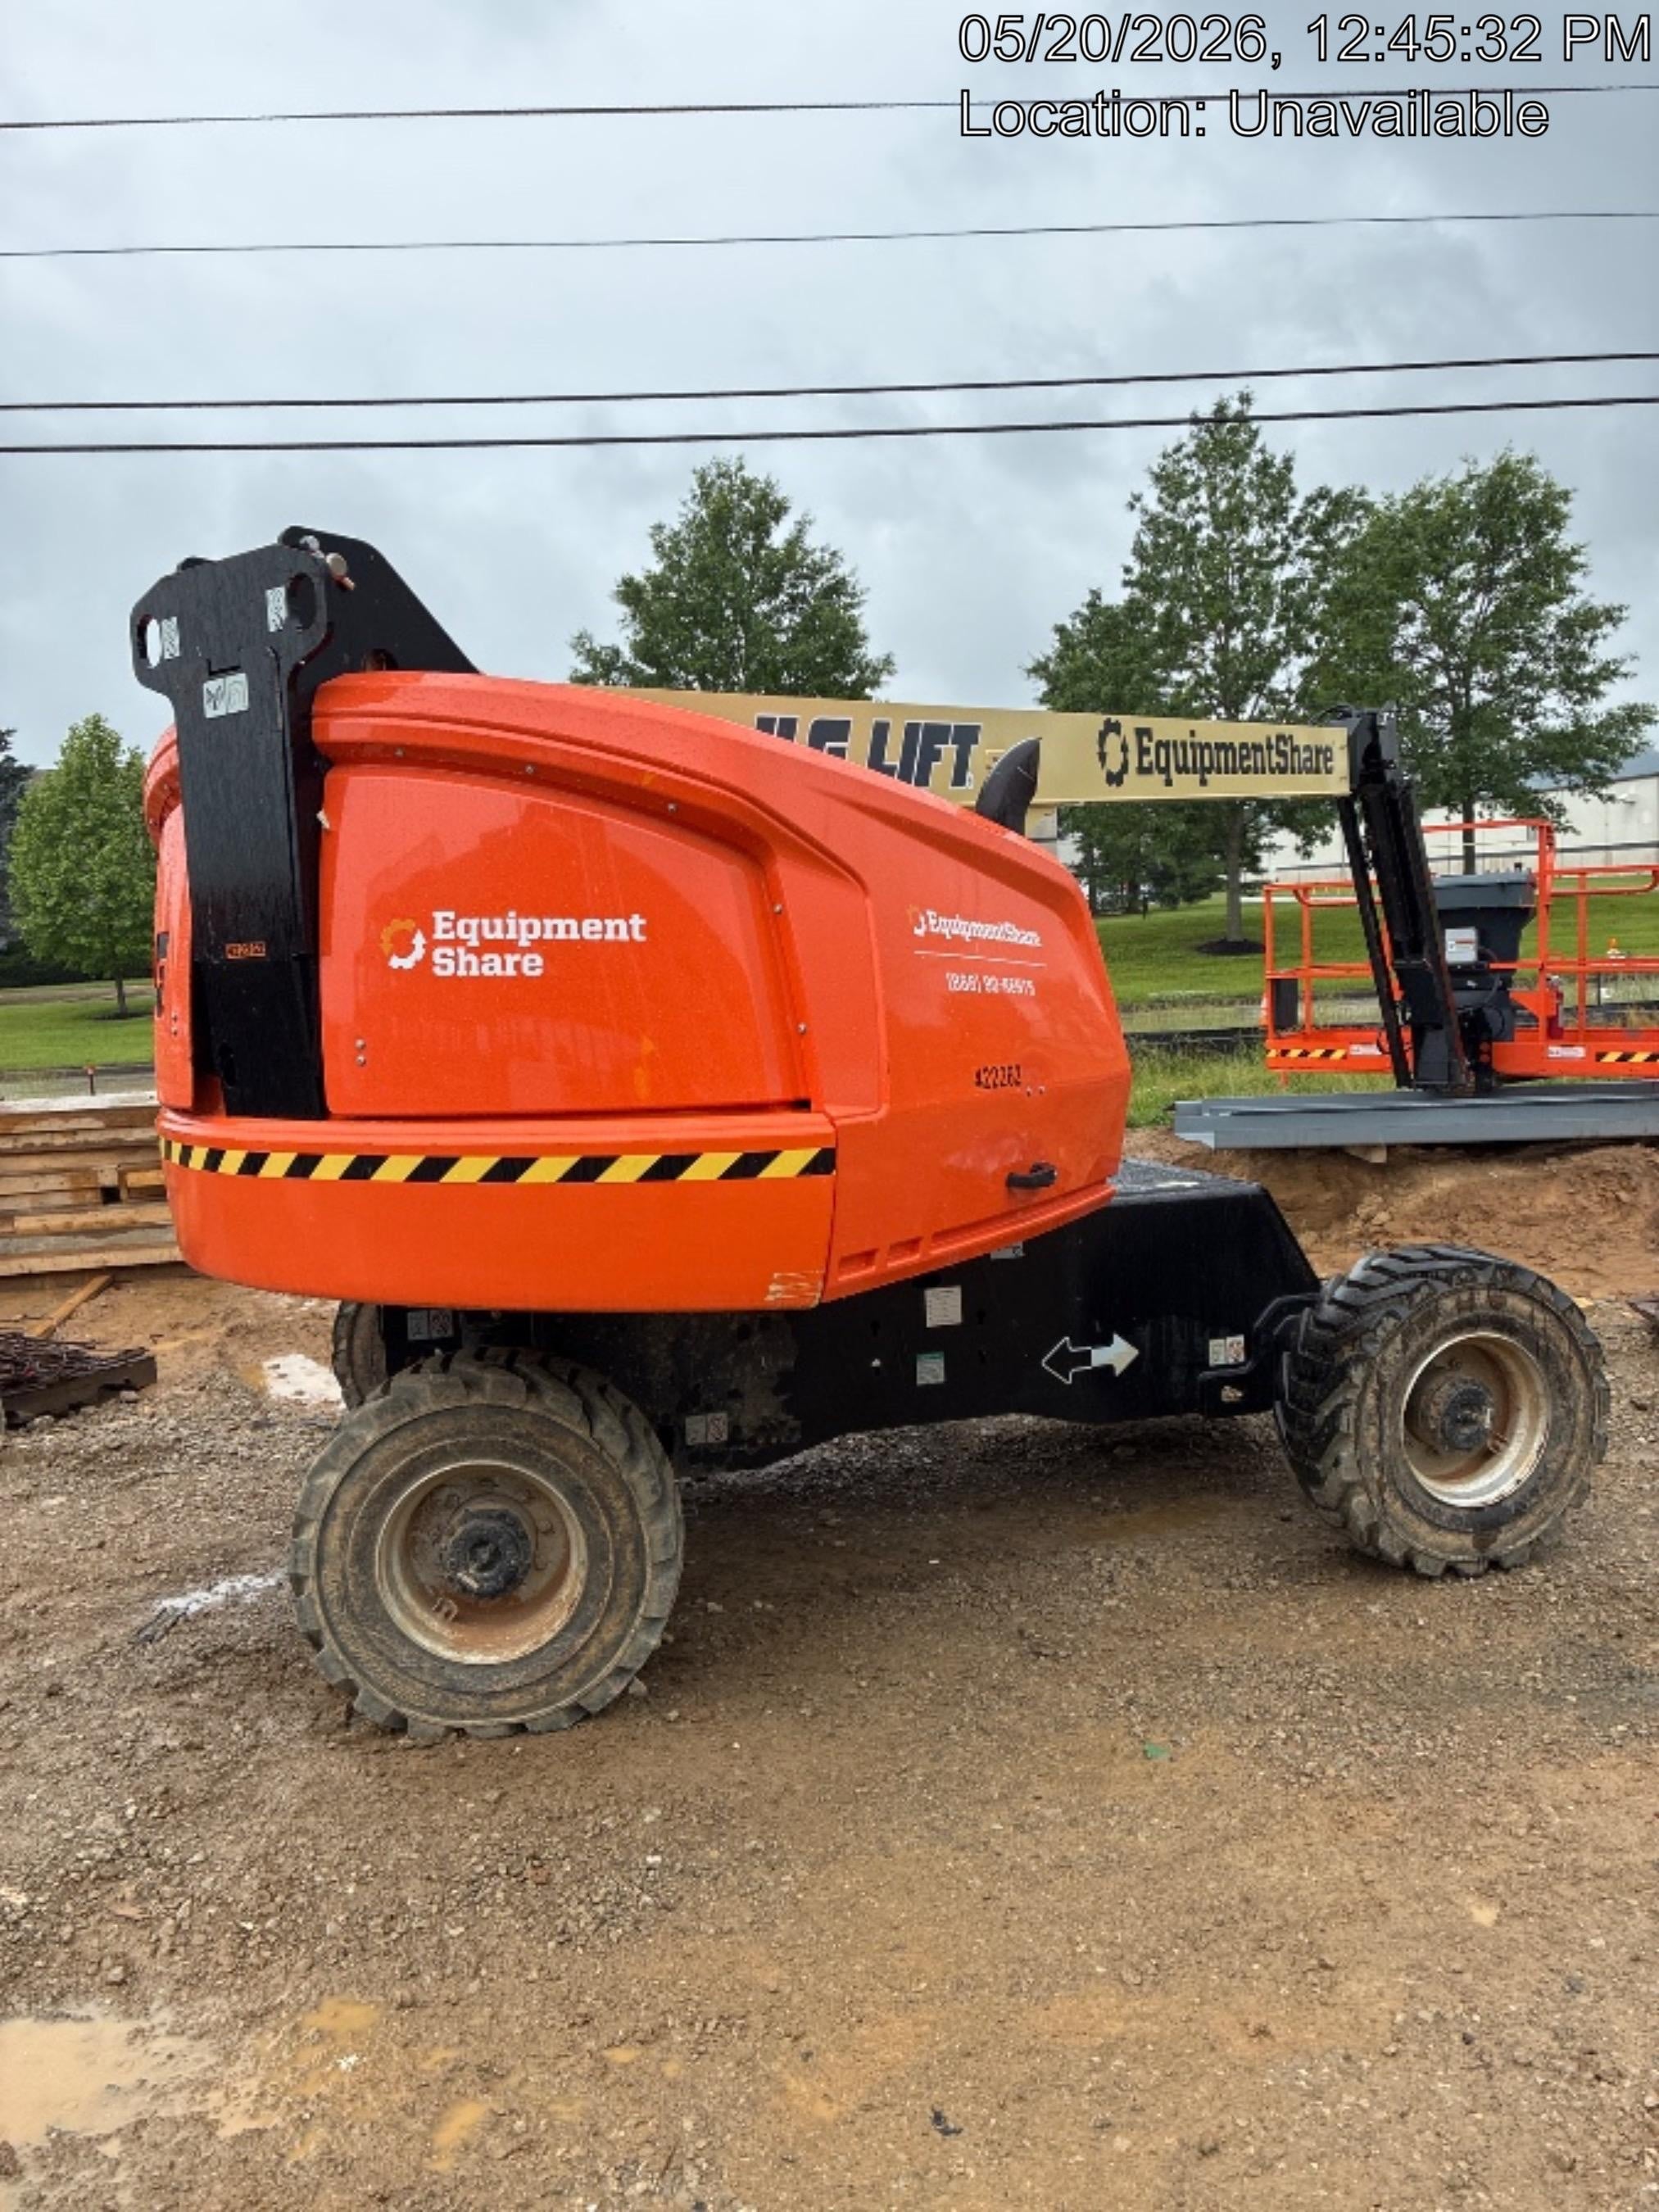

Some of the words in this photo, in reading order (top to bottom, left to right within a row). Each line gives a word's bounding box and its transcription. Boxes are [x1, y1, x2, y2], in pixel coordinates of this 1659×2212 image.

[868, 718, 982, 789] LIFT
[1135, 726, 1334, 786] EquipmentShare
[432, 910, 647, 947] Equipment
[432, 946, 544, 977] Share
